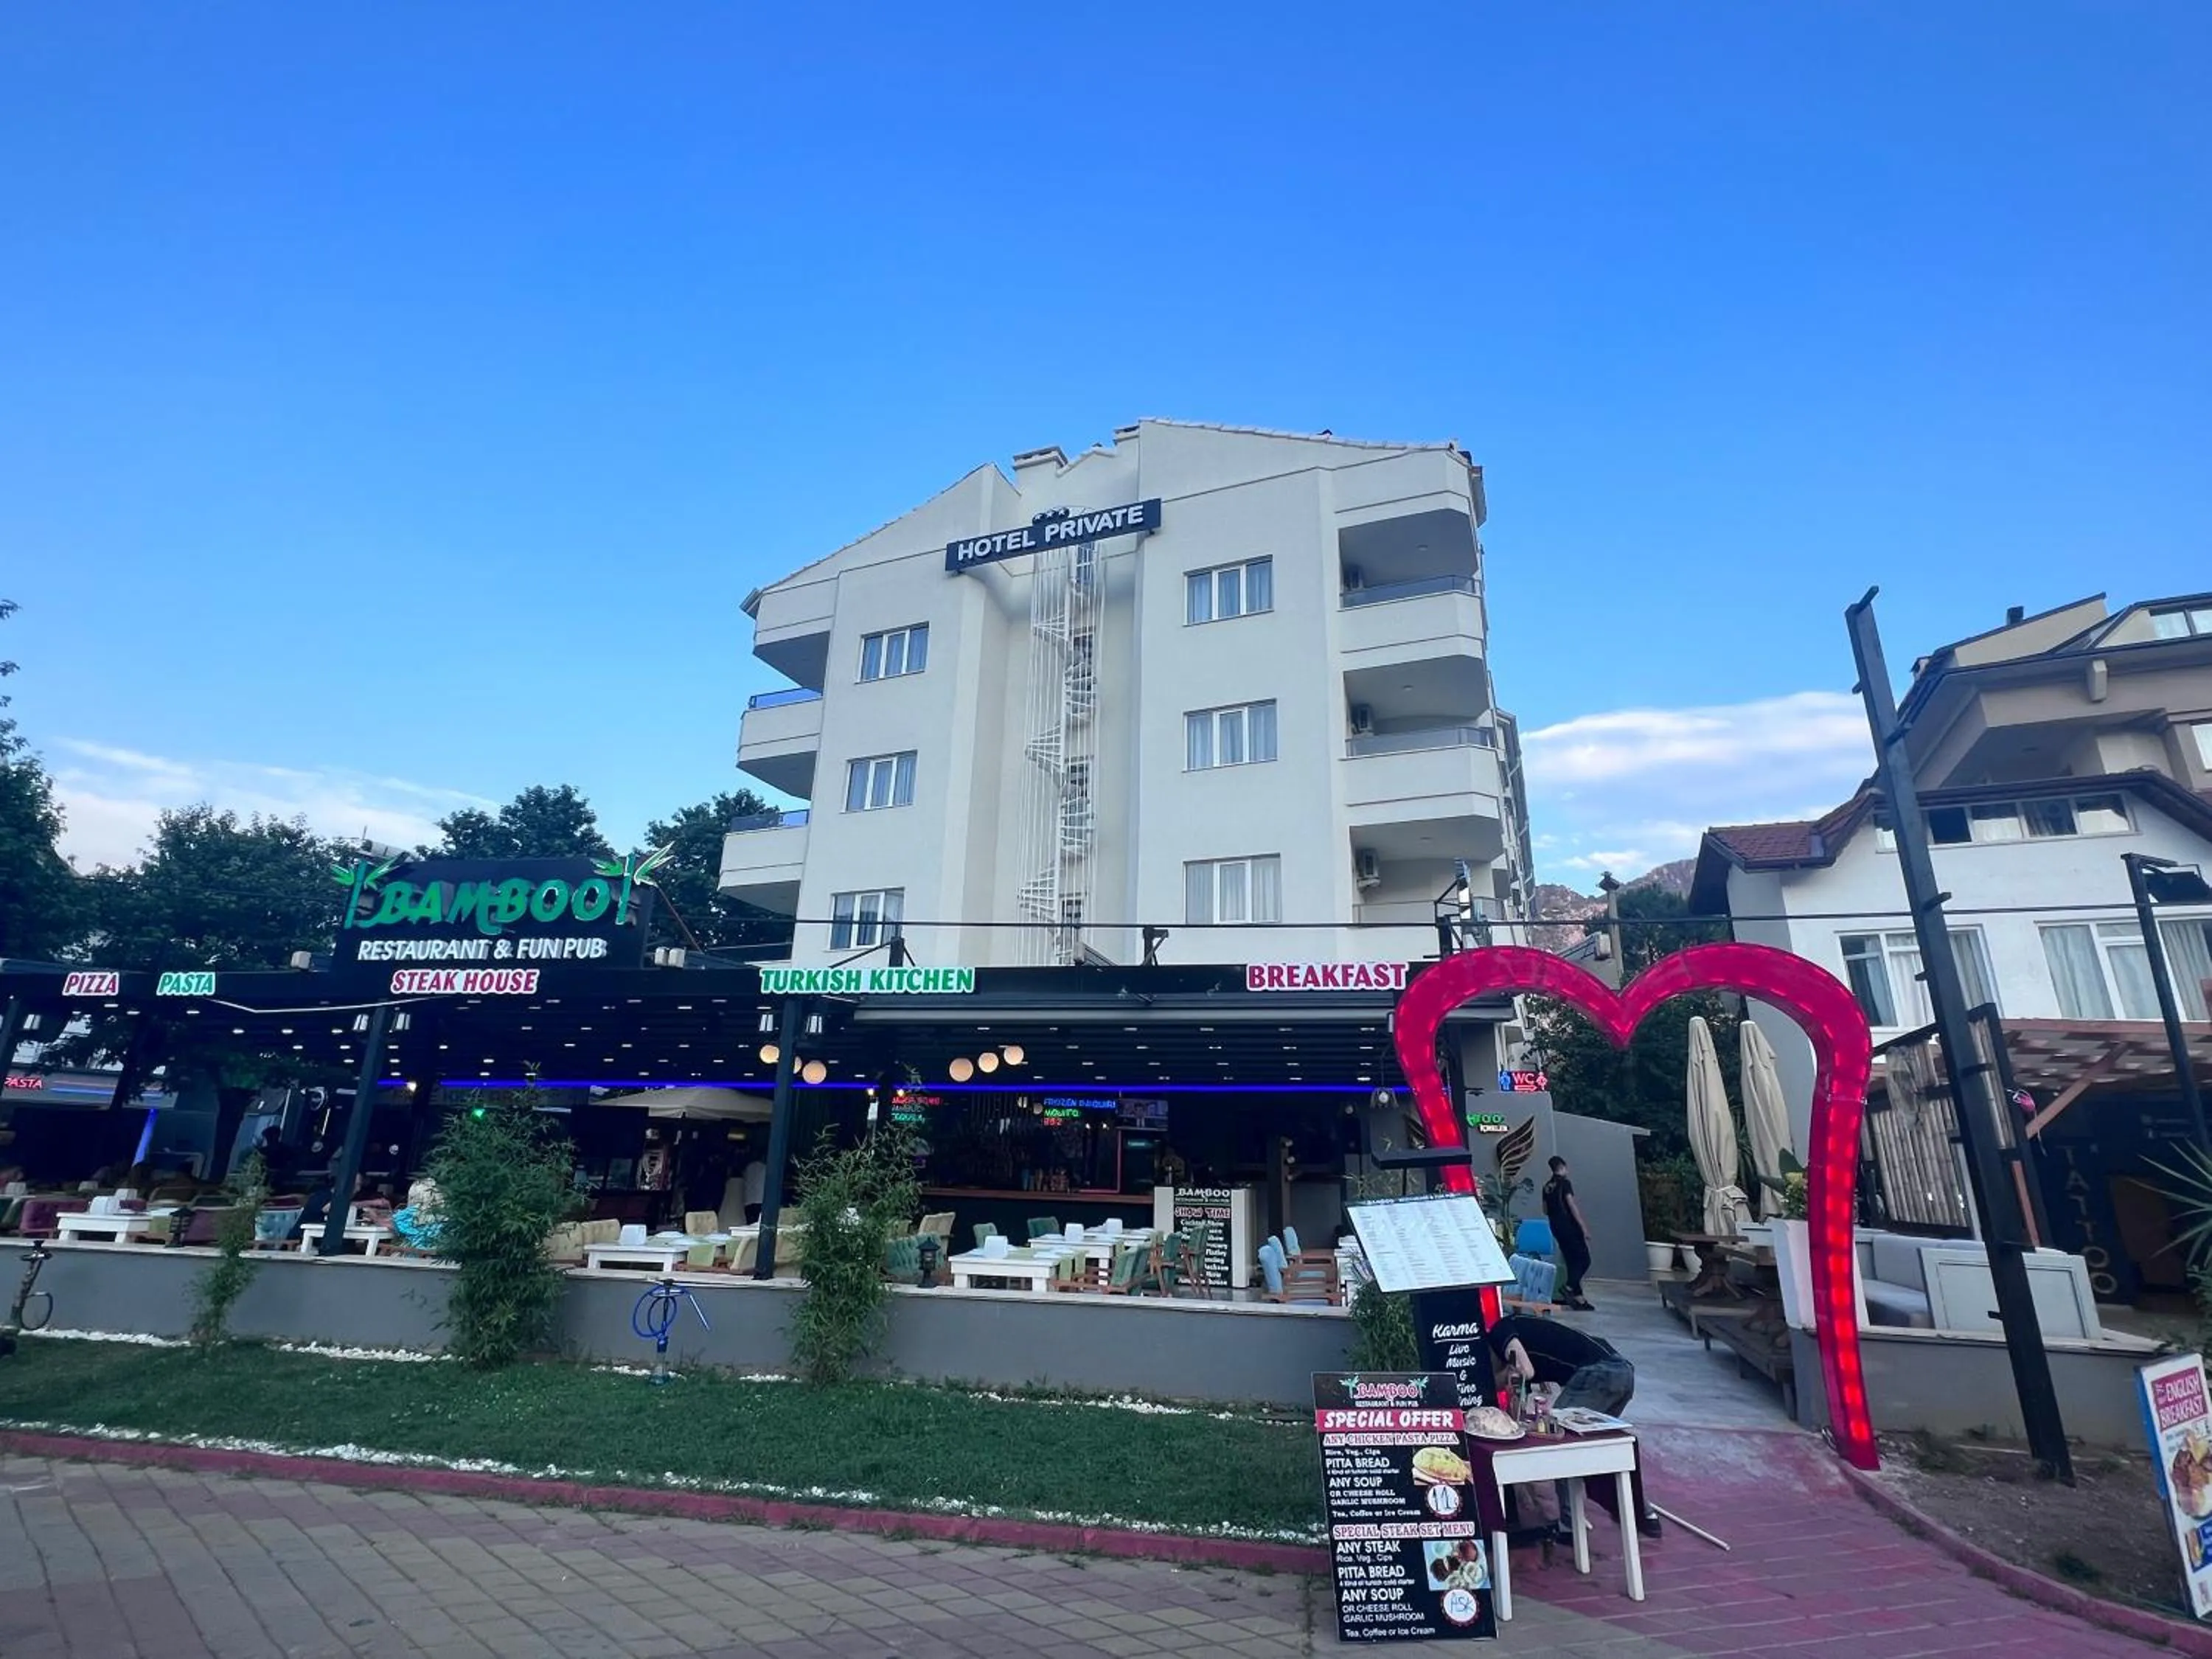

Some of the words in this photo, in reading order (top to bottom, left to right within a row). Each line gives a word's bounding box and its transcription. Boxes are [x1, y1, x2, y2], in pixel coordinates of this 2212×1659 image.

[958, 531, 1036, 561] HOTEL
[1045, 505, 1144, 543] PRIVATE
[355, 878, 611, 936] BAMBOO
[358, 939, 491, 960] RESTAURANT
[493, 939, 512, 959] &
[517, 938, 559, 959] FUN
[562, 938, 606, 959] PUB
[63, 973, 119, 995] PIZZA
[158, 973, 215, 995] PASTA
[392, 970, 458, 993] STEAK
[462, 970, 539, 993] HOUSE
[761, 968, 862, 992] TURKISH
[869, 968, 975, 992] KITCHEN
[1248, 964, 1407, 990] BREAKFAST
[1512, 1073, 1534, 1084] WC
[1175, 1188, 1230, 1197] BAMBOO
[1206, 1208, 1231, 1218] TIME
[1433, 1323, 1479, 1338] Karma
[1448, 1344, 1470, 1355] Live
[1446, 1355, 1476, 1368] Music
[1354, 1383, 1419, 1400] BAMBOO
[2166, 1372, 2201, 1402] ENGLISH
[2159, 1395, 2204, 1428] BREAKFAST
[1324, 1411, 1394, 1428] SPECIAL
[1399, 1411, 1453, 1427] OFFER
[1324, 1434, 1346, 1445] ANY
[1347, 1433, 1393, 1444] CHICKEN
[1395, 1433, 1425, 1444] PASTA
[1429, 1433, 1459, 1444] PIZZA
[1326, 1458, 1352, 1468] PITTA
[1355, 1458, 1390, 1467] BREAD
[1329, 1478, 1351, 1487] ANY
[1353, 1477, 1382, 1487] SOUP
[1334, 1526, 1379, 1538] SPECIAL
[1381, 1524, 1418, 1537] STEAK
[1419, 1523, 1441, 1537] SET
[1443, 1523, 1474, 1536] MENU
[1336, 1542, 1362, 1554] ANY
[1365, 1540, 1401, 1552] STEAK
[1338, 1567, 1366, 1579] PITTA
[1368, 1565, 1405, 1578] BREAD
[1342, 1590, 1367, 1601] ANY
[1371, 1588, 1404, 1601] SOUP
[1357, 1604, 1390, 1613] CHEESE
[1391, 1604, 1413, 1612] ROLL
[1343, 1615, 1373, 1623] GARLIC
[1375, 1613, 1425, 1622] MUSHROOM
[1363, 1628, 1387, 1637] Coffee
[1411, 1627, 1436, 1635] Cream
